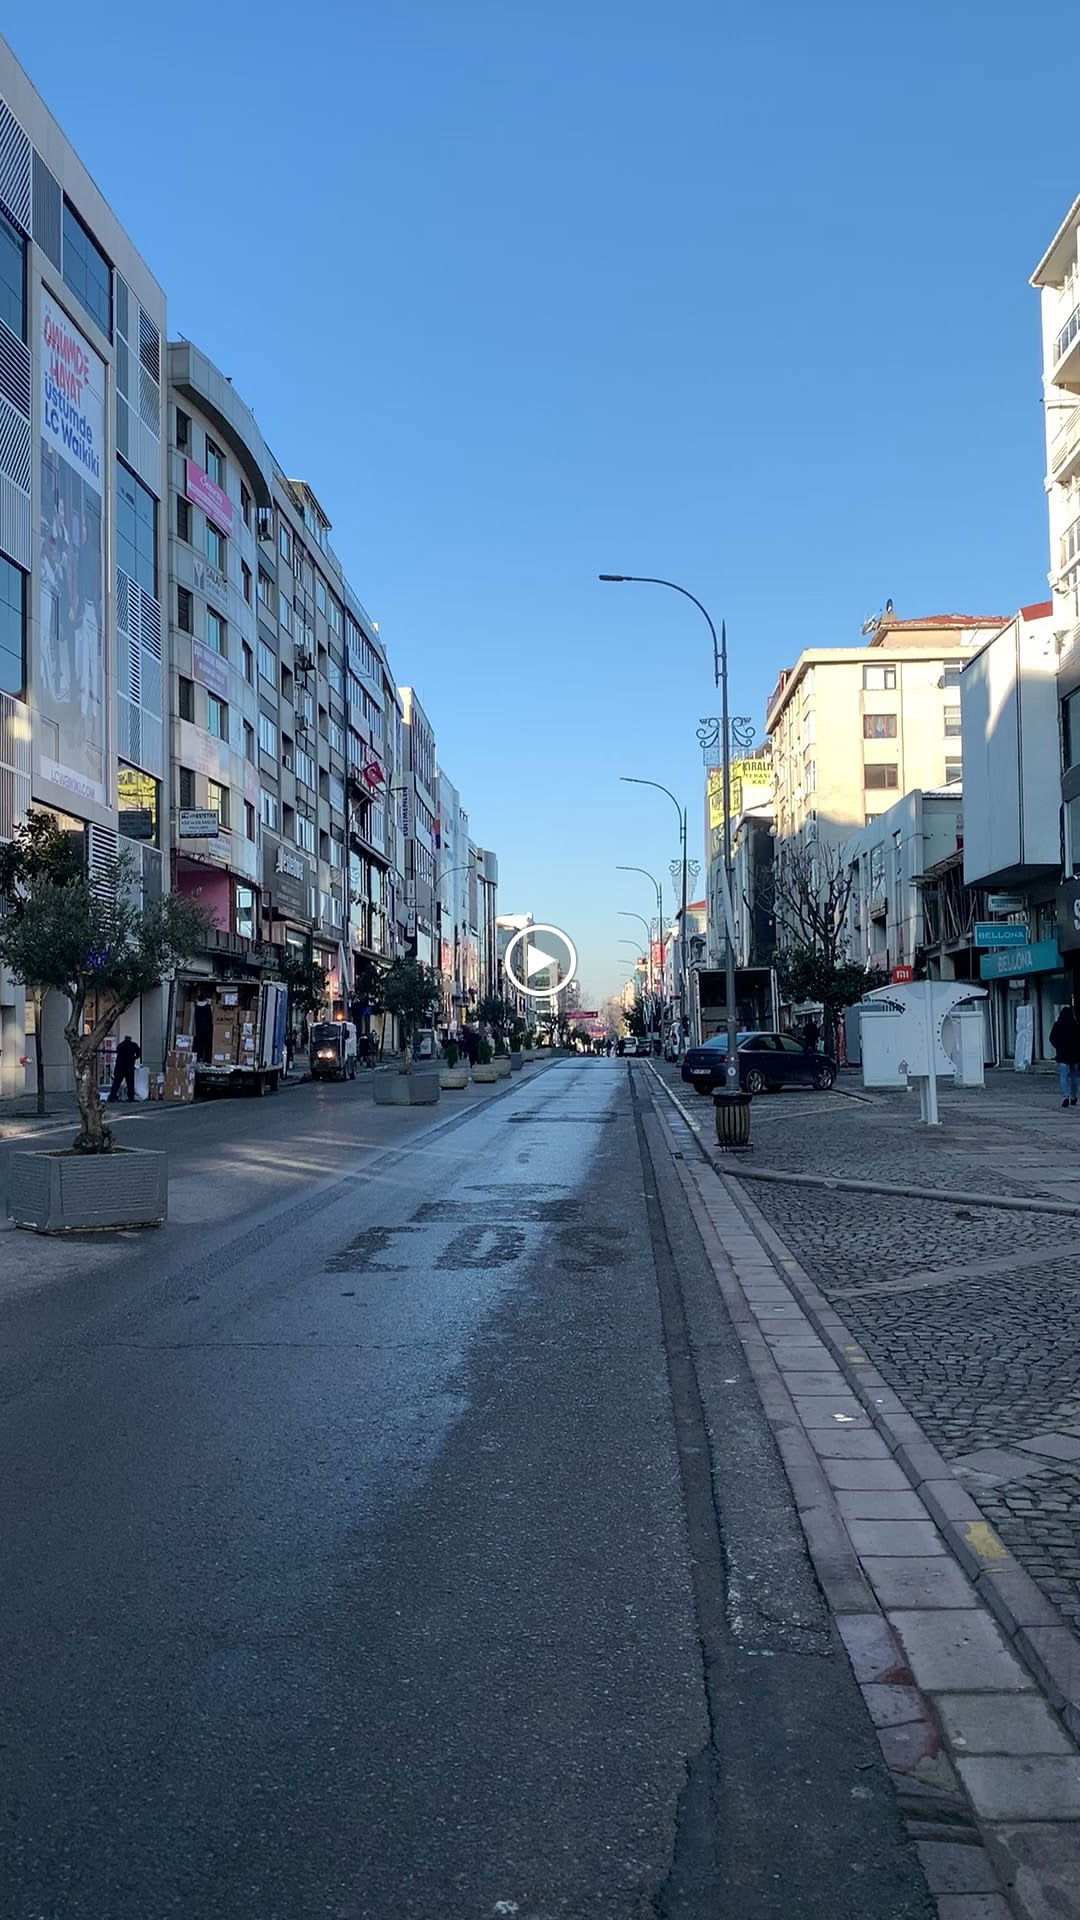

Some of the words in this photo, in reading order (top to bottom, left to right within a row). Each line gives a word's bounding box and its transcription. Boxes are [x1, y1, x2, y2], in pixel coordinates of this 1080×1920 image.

[44, 371, 93, 445] üstümde
[49, 351, 83, 409] HAYAT
[44, 400, 60, 435] LC
[60, 417, 100, 479] Waikiki
[978, 931, 1025, 939] BELLONA
[997, 950, 1033, 973] BELLONA
